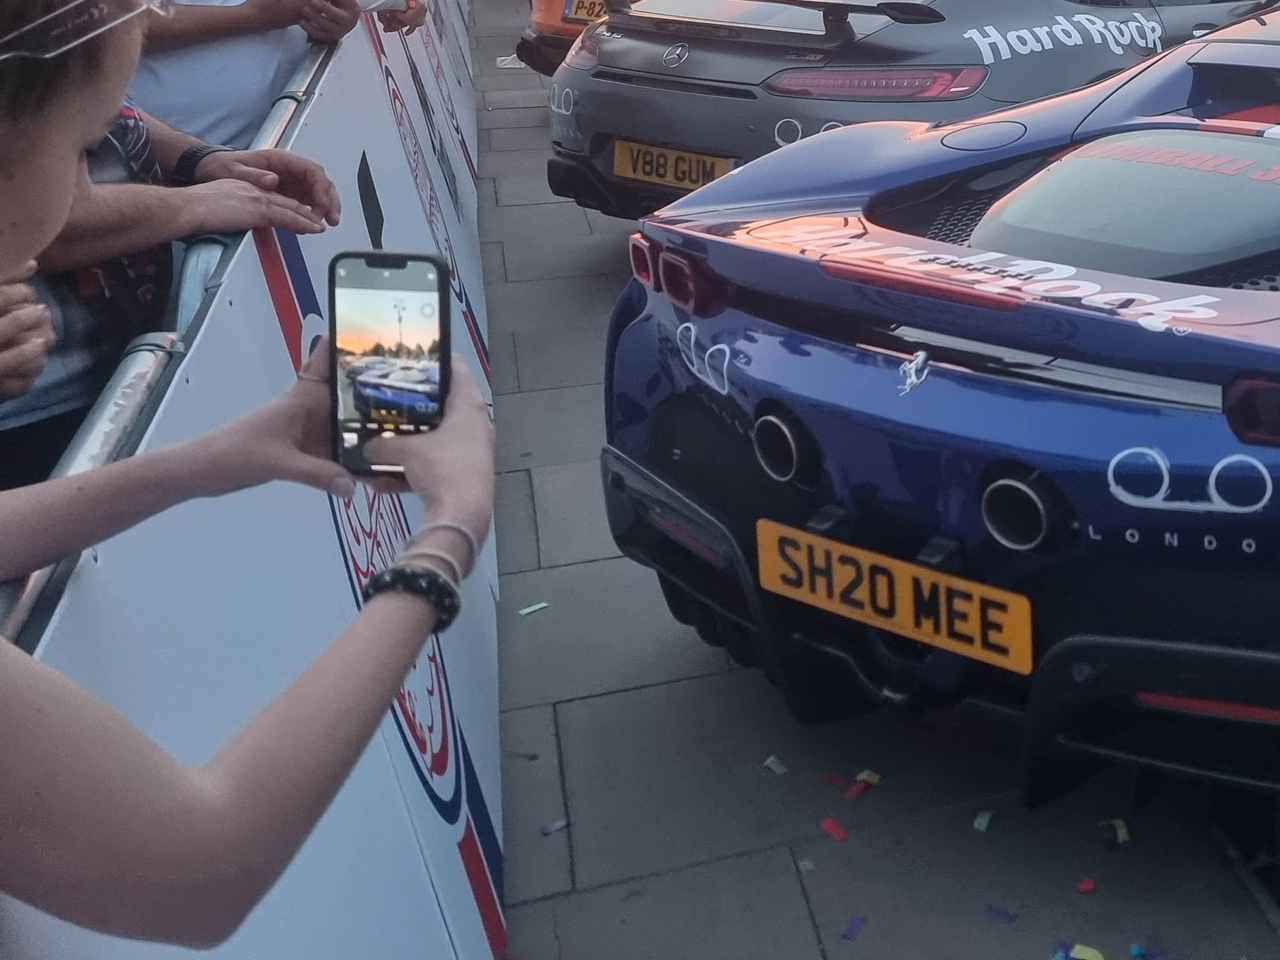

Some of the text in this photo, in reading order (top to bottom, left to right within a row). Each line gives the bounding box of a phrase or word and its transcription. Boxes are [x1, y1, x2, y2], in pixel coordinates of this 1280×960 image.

[574, 0, 609, 18] P-82
[963, 12, 1163, 65] Hard Rock
[629, 147, 717, 185] V88 GUM
[974, 258, 1221, 332] Rock
[778, 535, 1010, 657] SH20 MEE
